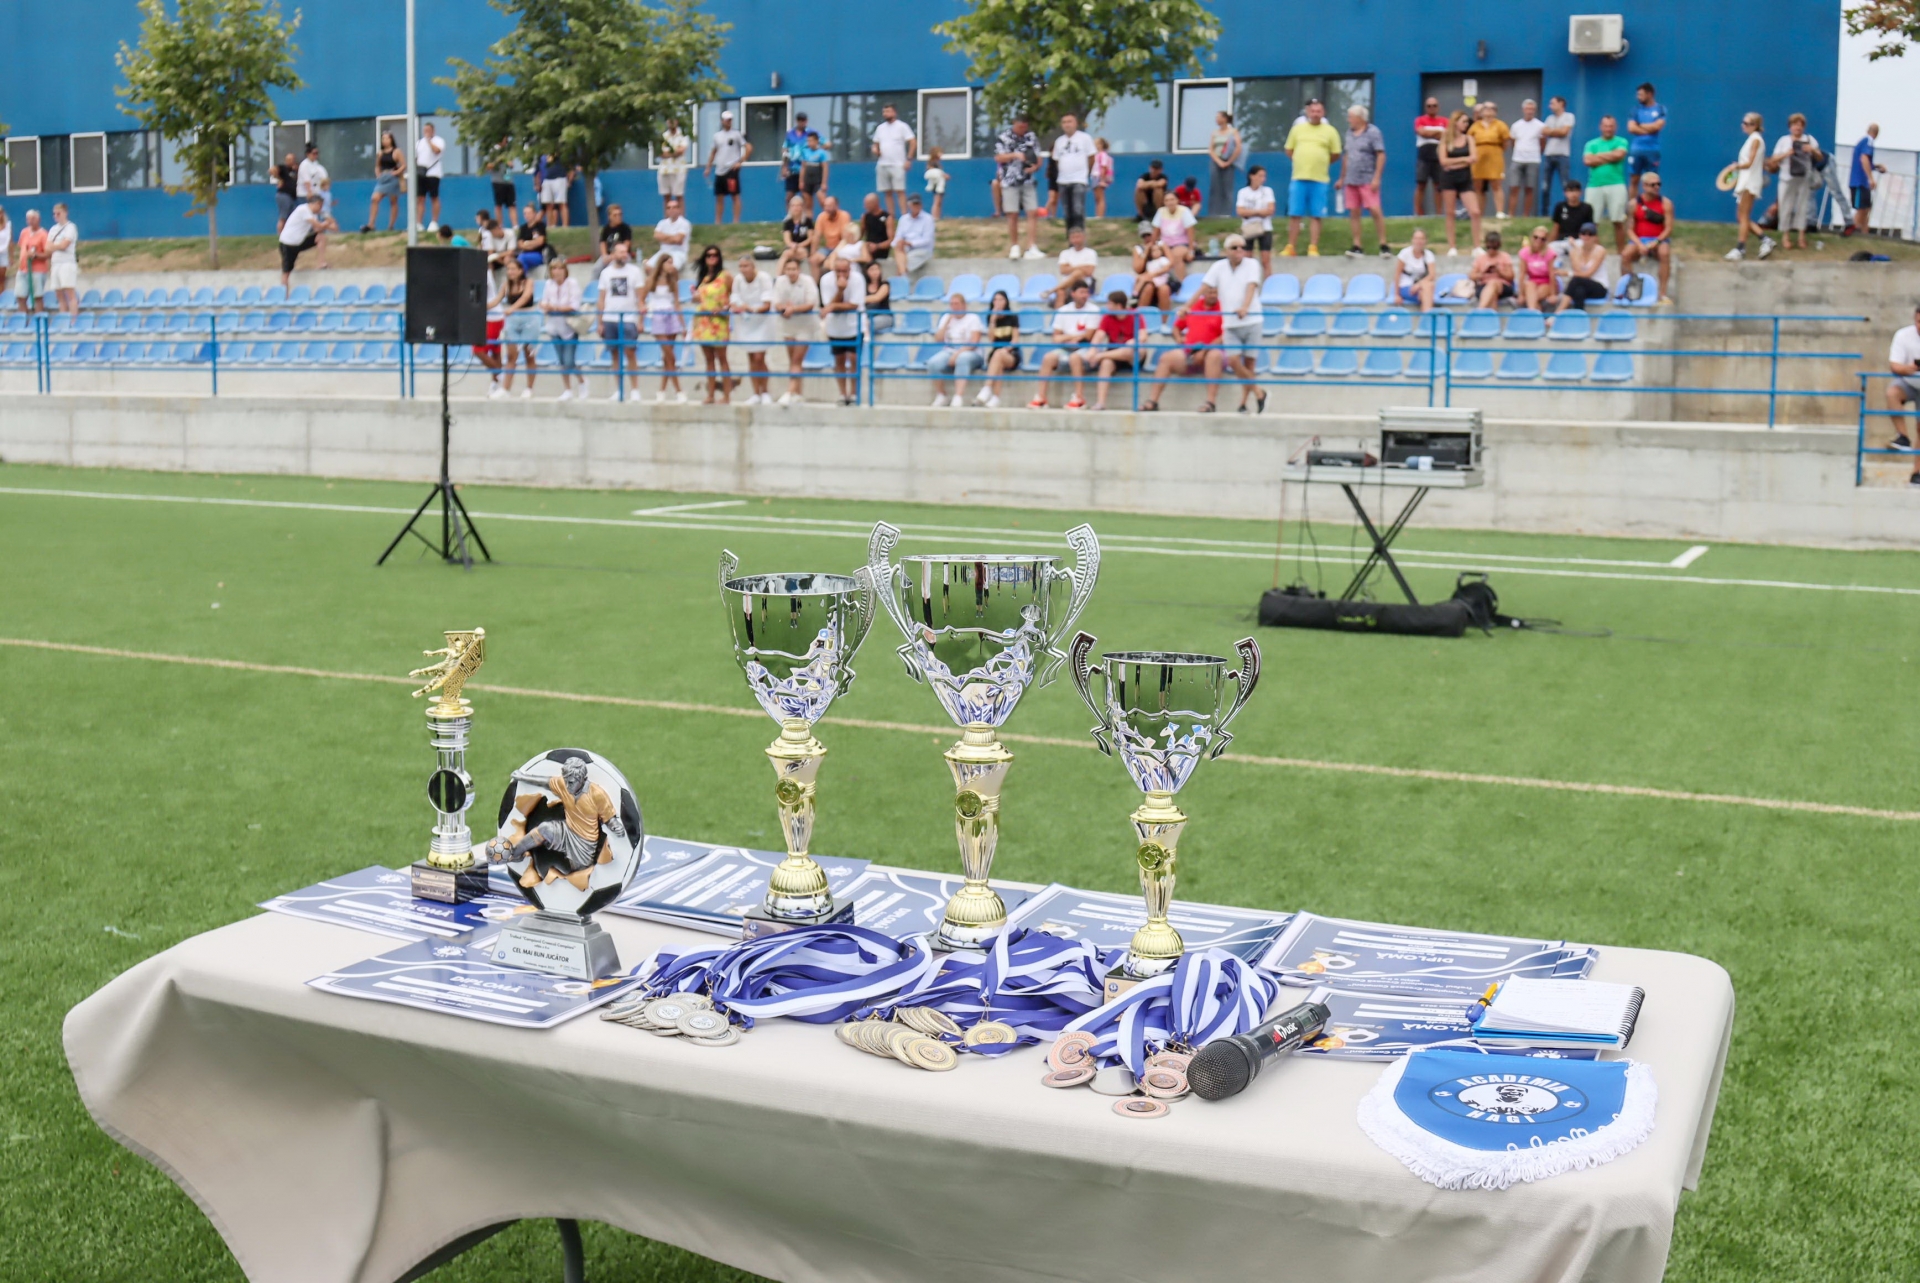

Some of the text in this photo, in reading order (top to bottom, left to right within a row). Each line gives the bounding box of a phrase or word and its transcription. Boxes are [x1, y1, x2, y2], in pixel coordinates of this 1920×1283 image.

[512, 946, 570, 963] CEL MAI BUN JUCĂTOR
[1376, 951, 1454, 964] DIPLOMĂ
[450, 975, 525, 993] DIPLOMĂ
[1456, 1074, 1571, 1093] ACADEMIA
[1466, 1111, 1536, 1124] HAGI
